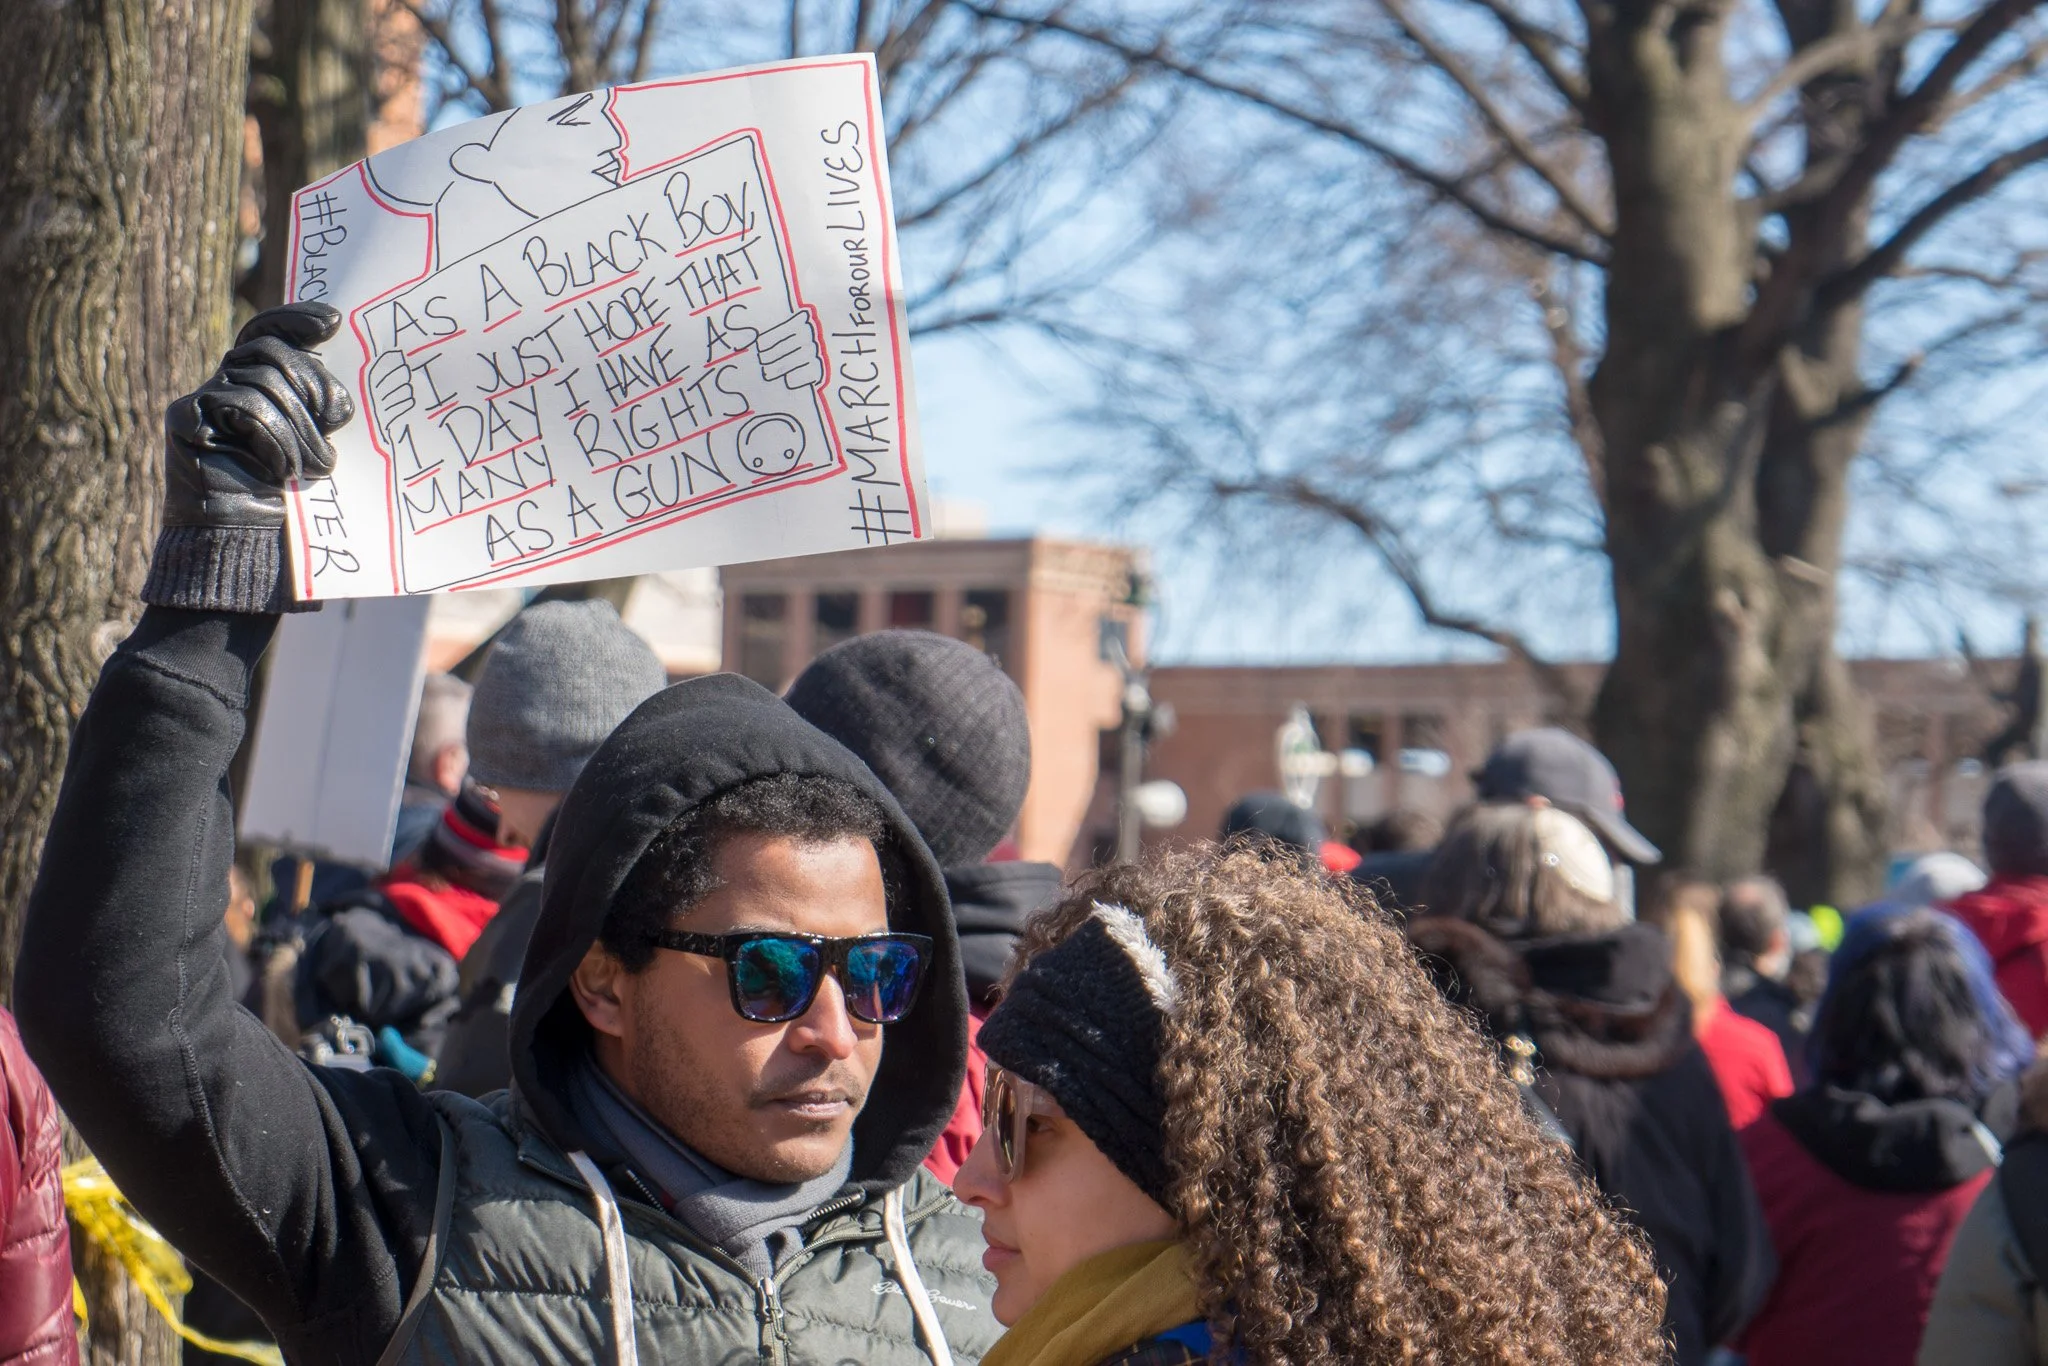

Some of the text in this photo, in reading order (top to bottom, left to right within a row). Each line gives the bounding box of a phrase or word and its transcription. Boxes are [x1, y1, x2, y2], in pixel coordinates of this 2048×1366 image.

[393, 172, 755, 347] AS A BLACK BOY
[412, 236, 761, 410] I JUST HOPE THAT
[402, 364, 750, 531] MANY RIGHTS
[438, 385, 542, 467] DAY
[554, 368, 590, 416] I
[597, 324, 690, 407] HAVE
[707, 304, 759, 362] AS
[486, 431, 731, 561] AS A GUN
